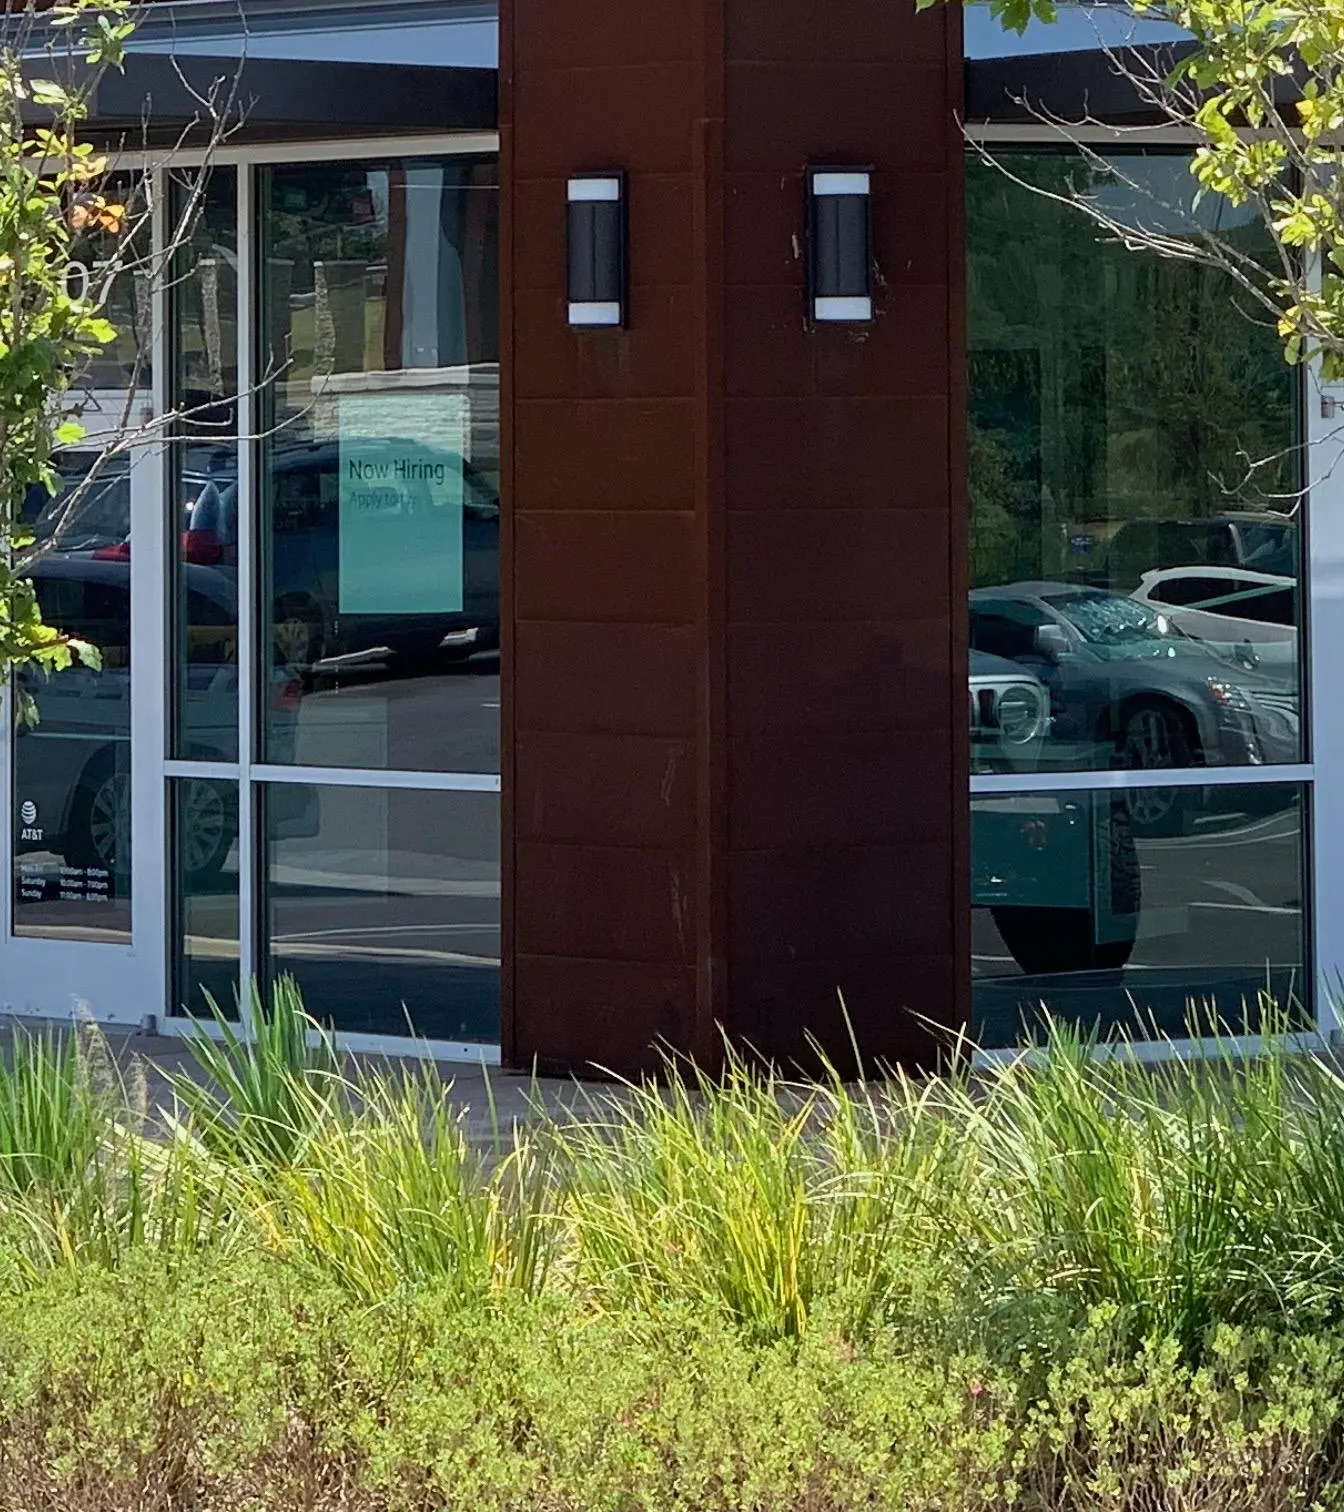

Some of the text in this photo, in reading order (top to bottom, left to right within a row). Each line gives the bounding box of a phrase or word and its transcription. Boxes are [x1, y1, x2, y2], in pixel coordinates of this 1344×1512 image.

[349, 458, 445, 486] Now Hiring
[21, 829, 43, 840] AT&T
